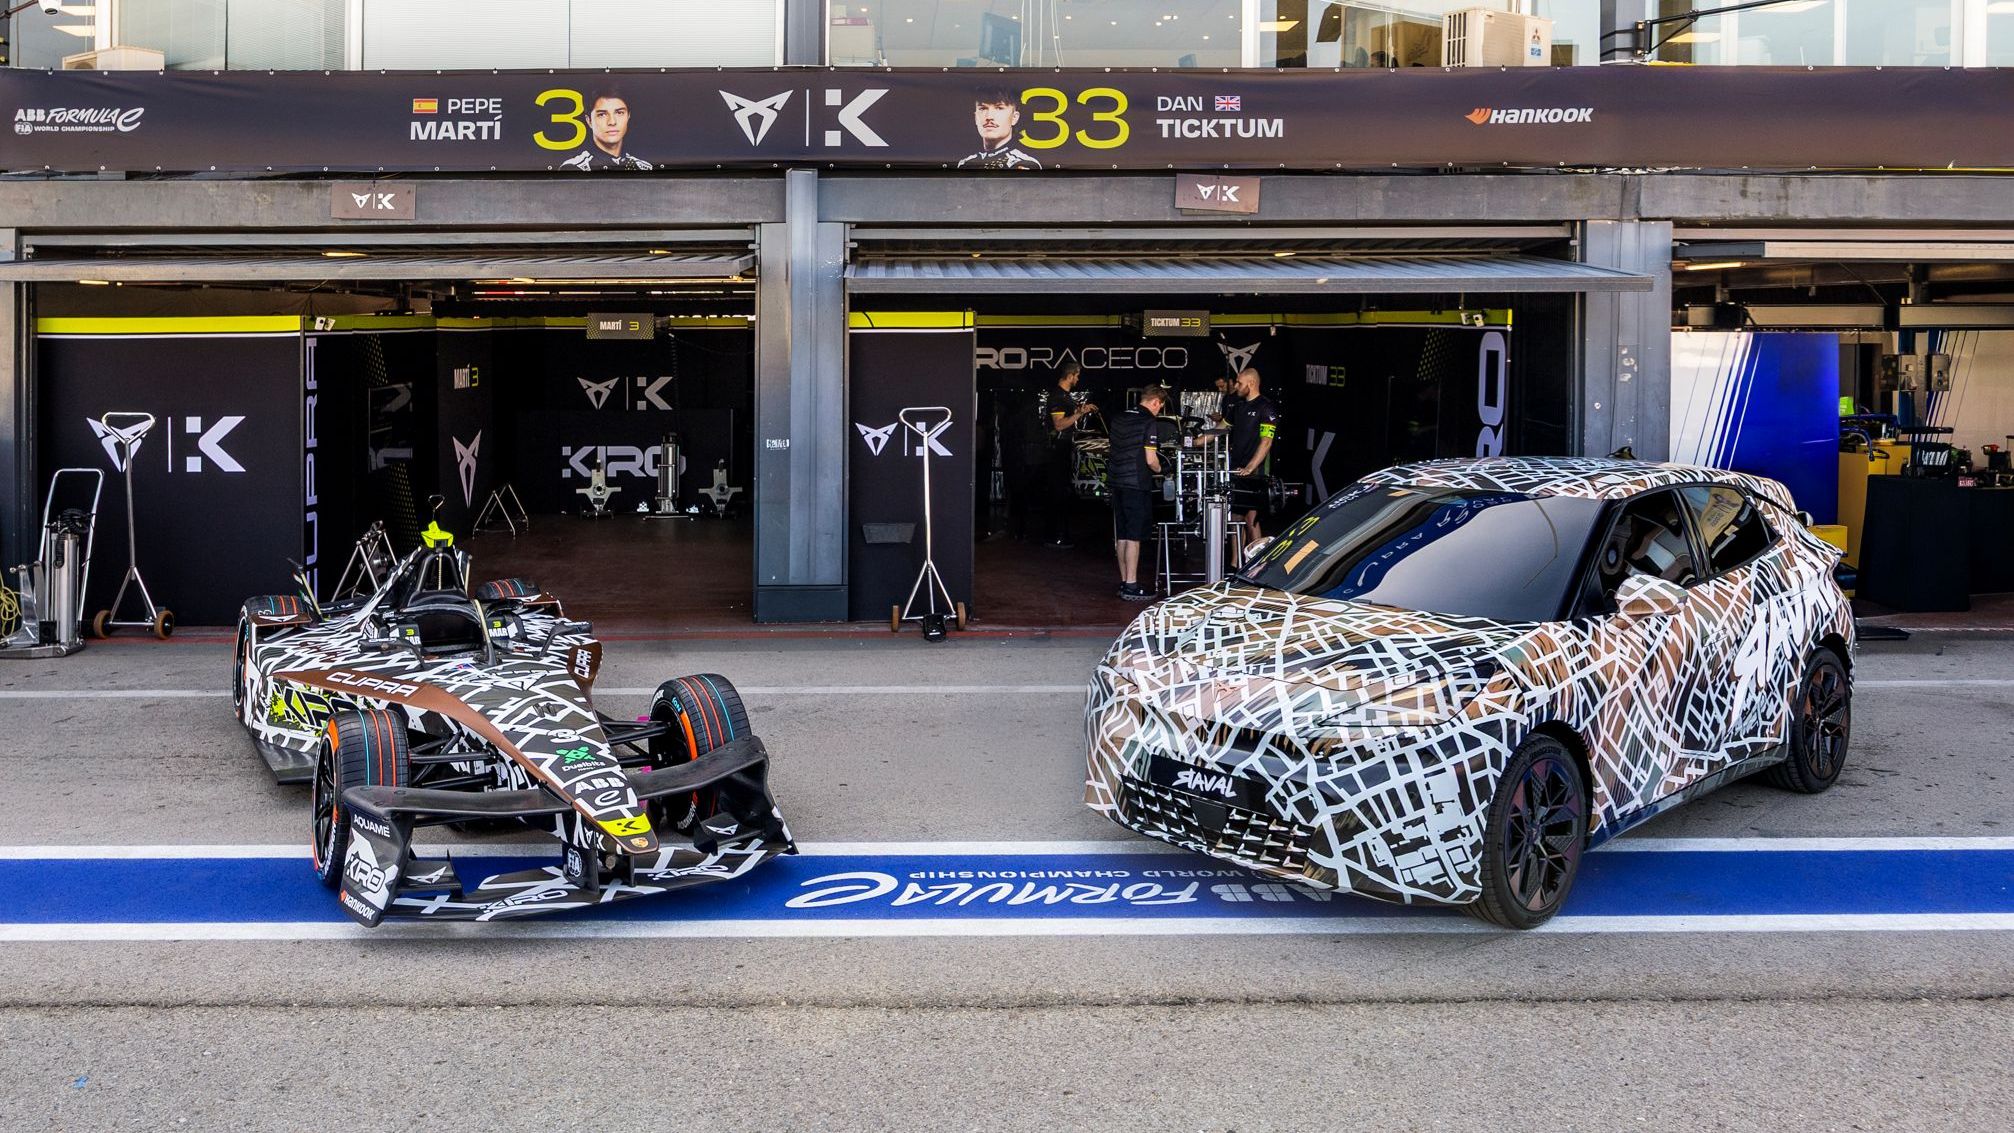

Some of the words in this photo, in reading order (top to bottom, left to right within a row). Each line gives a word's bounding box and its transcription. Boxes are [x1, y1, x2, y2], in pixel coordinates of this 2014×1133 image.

[447, 98, 502, 114] PEPE
[1157, 96, 1203, 112] DAN
[15, 109, 45, 121] ABB
[46, 108, 121, 124] FORMULA
[533, 88, 587, 150] 3
[1018, 87, 1130, 149] 33
[410, 115, 502, 141] MARTÍ
[1156, 118, 1284, 138] TICKTUM
[629, 321, 640, 331] 3
[1151, 317, 1180, 327] TICKTUM
[1181, 317, 1201, 327] 33
[326, 672, 419, 697] CUPRA
[548, 729, 581, 743] 3
[575, 778, 625, 794] ABB
[909, 870, 1129, 878] CHAMPIONSHIP
[1141, 869, 1245, 877] WORLD
[892, 881, 1200, 906] FORMULA
